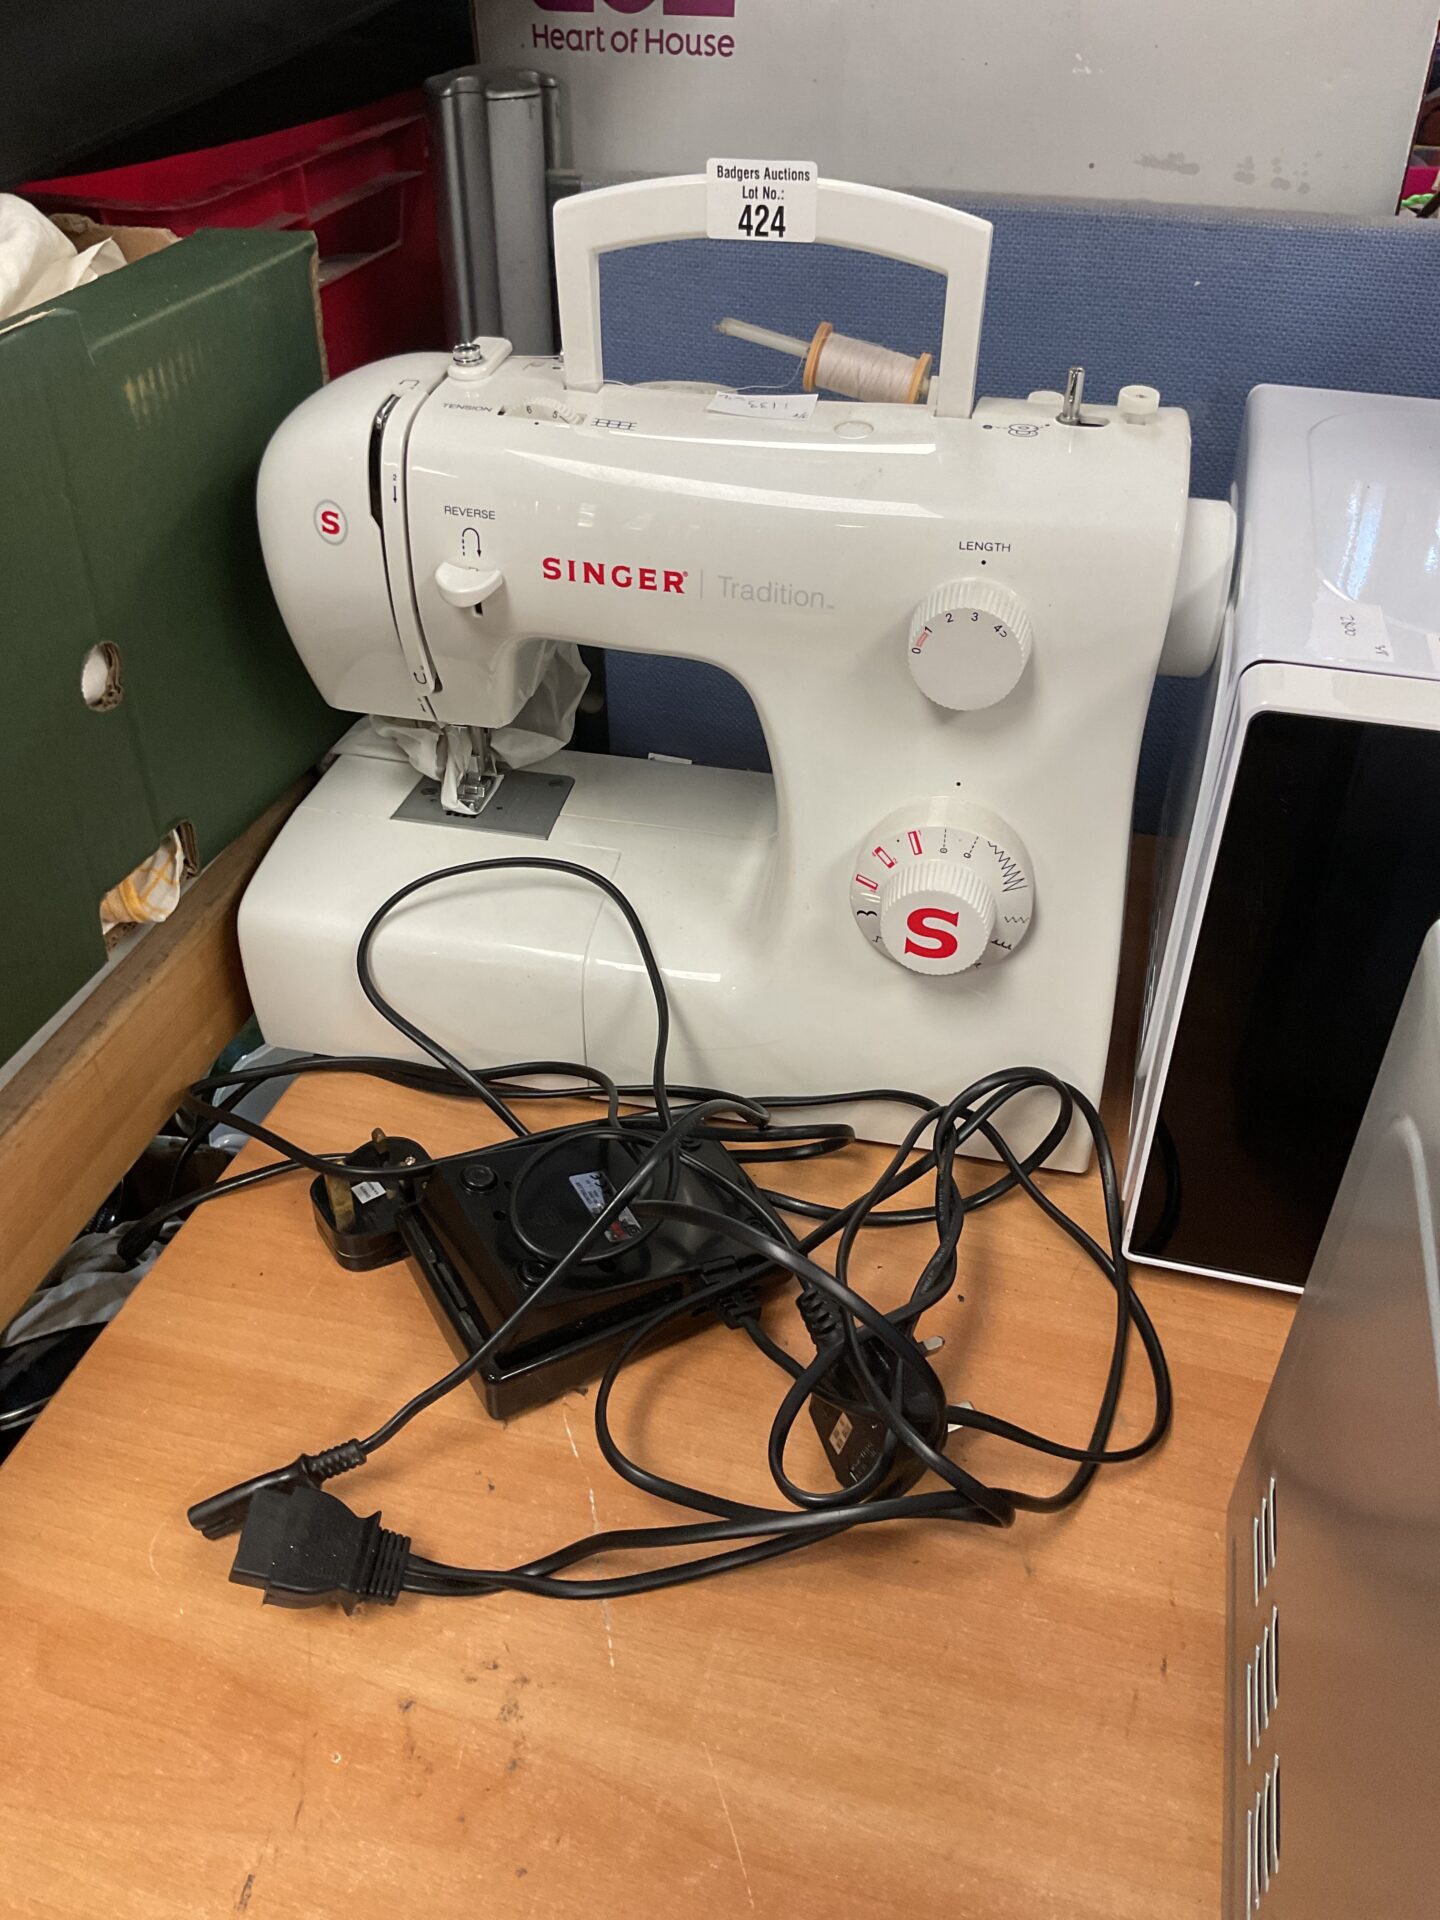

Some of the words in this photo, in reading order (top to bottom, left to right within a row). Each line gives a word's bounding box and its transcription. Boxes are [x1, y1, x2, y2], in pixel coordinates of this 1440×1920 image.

[532, 24, 605, 52] Heart
[610, 28, 638, 53] of
[645, 28, 735, 57] House
[717, 165, 760, 182] Badgers
[764, 167, 810, 181] Auctions
[742, 185, 758, 200] Lot
[762, 186, 784, 200] No.:
[738, 204, 786, 238] 424
[443, 403, 493, 413] TENSION
[526, 405, 533, 414] 6
[444, 505, 496, 521] REVERSE
[321, 510, 340, 535] S
[958, 541, 1011, 552] LENGTH
[542, 557, 685, 594] SINGER
[717, 575, 826, 608] Tradition
[945, 613, 954, 623] 2
[971, 612, 979, 621] 3
[911, 647, 921, 655] 0
[904, 908, 959, 959] S
